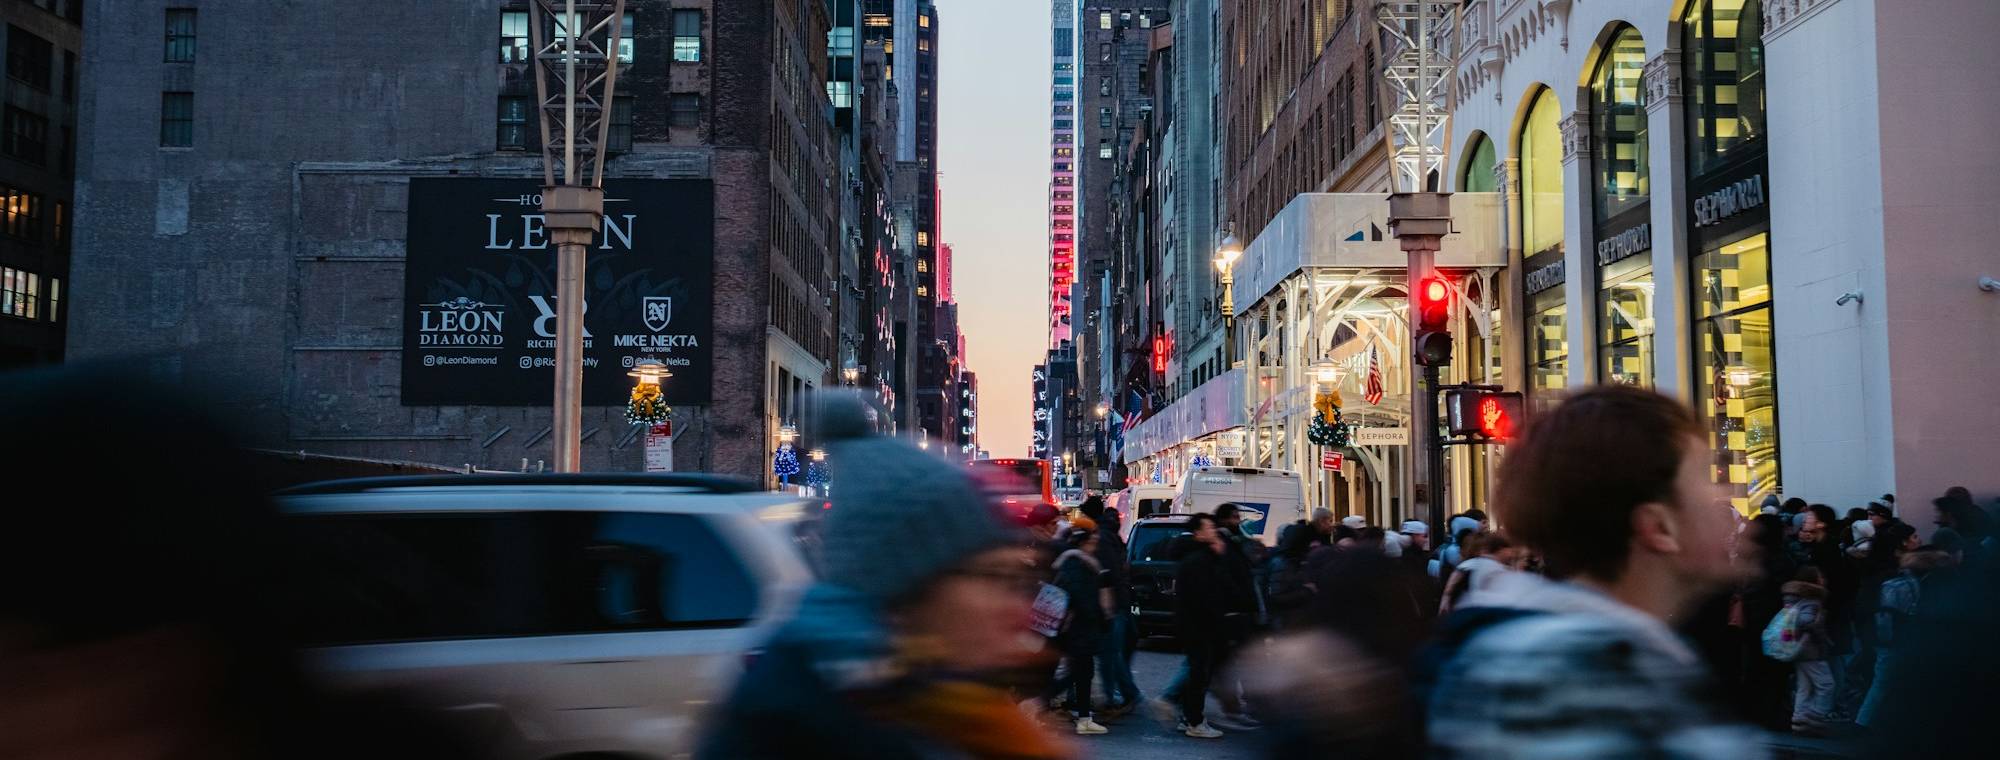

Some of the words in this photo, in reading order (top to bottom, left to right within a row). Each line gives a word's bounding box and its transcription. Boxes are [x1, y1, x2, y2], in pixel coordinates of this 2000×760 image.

[1694, 174, 1763, 227] SEPHORA
[485, 214, 637, 250] LEN
[1598, 223, 1650, 266] SEPHORA
[419, 310, 504, 332] LEON
[420, 334, 504, 345] DIAMOND
[614, 334, 647, 347] MIKE
[651, 334, 698, 347] NEKTA
[436, 356, 498, 365] @LeonDiamond
